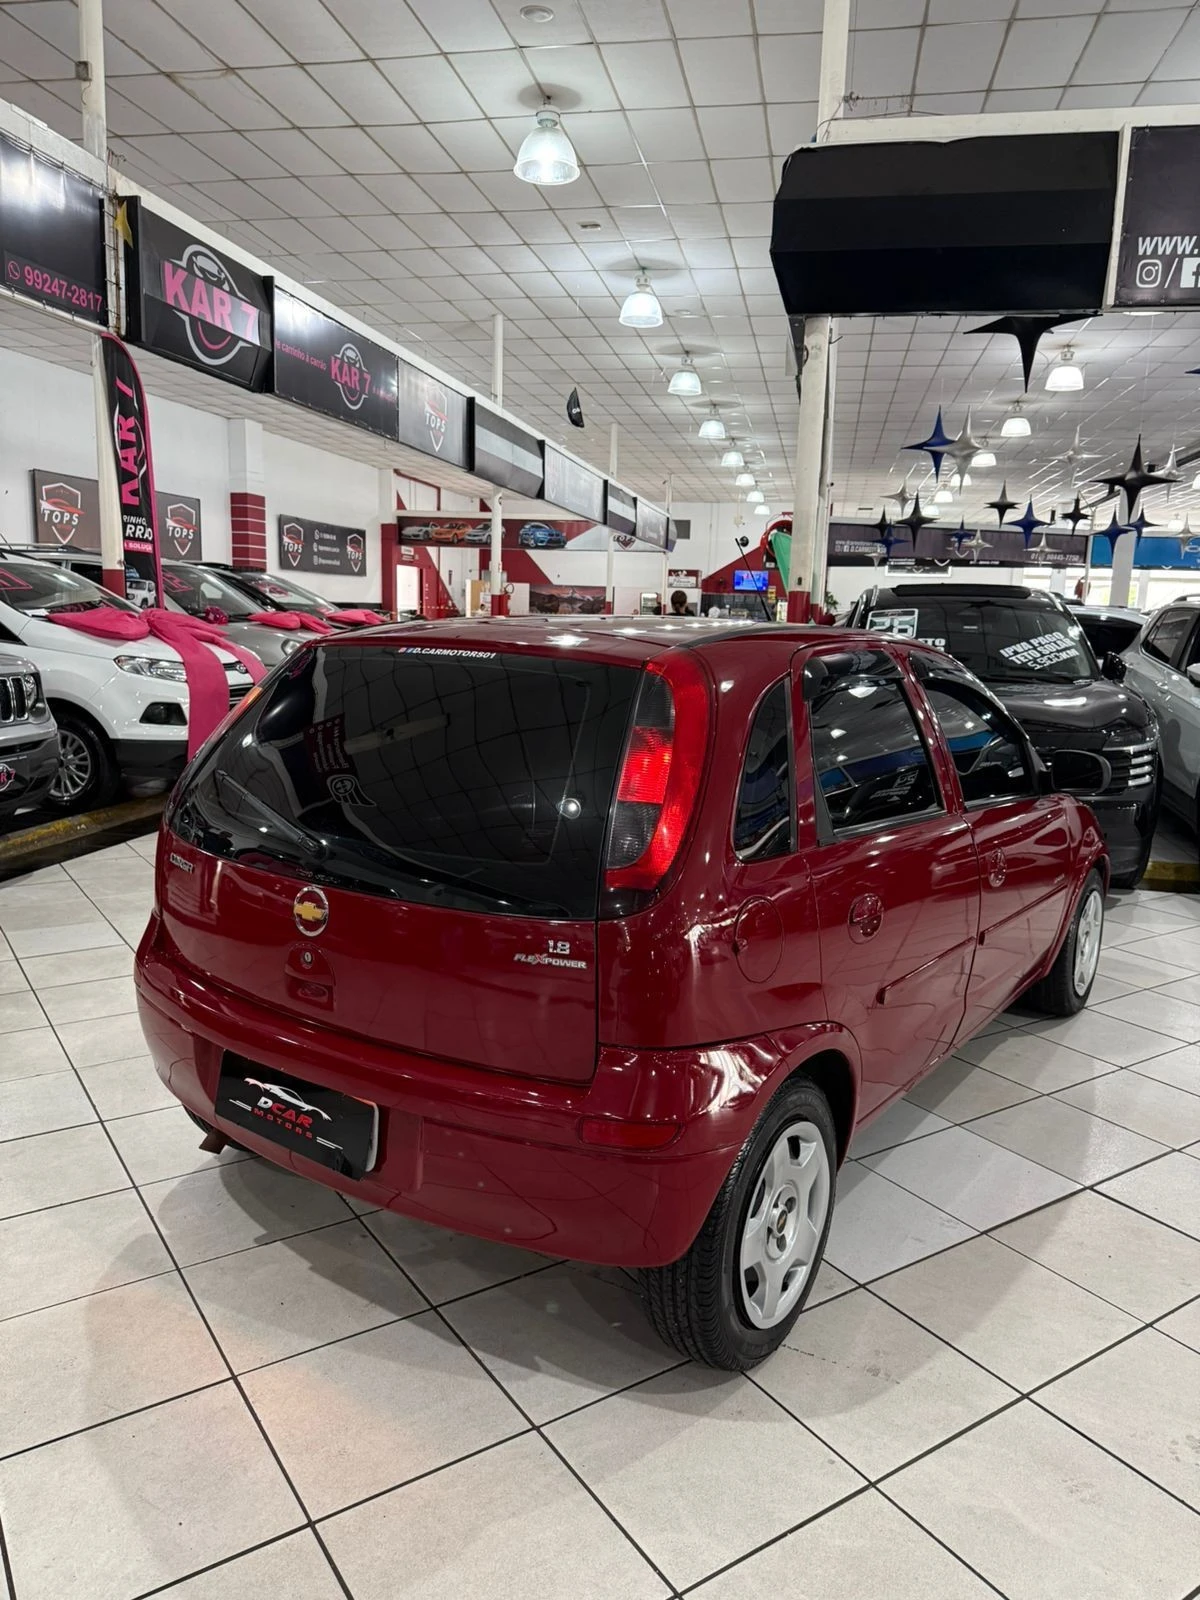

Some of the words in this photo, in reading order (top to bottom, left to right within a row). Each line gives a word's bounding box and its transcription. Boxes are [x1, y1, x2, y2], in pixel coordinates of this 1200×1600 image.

[24, 265, 103, 313] 99247-2817
[164, 260, 235, 335] KAR
[240, 300, 258, 344] 7
[331, 356, 360, 392] KAR
[363, 372, 371, 394] 7
[425, 412, 446, 433] TOPS
[44, 510, 79, 526] TOPS
[168, 526, 194, 540] TOPS
[284, 543, 303, 553] TOPS
[347, 551, 363, 560] TOPS
[412, 647, 497, 660] D.CARMOTORS01
[1000, 641, 1034, 658] IPVA
[1029, 631, 1065, 648] PAGO
[1008, 649, 1042, 665] TETO
[1037, 637, 1076, 655] SOLAR
[548, 940, 571, 954] 1.8
[513, 953, 587, 969] FLEXPOWER
[253, 1107, 313, 1139] MOTORS
[257, 1096, 313, 1129] DCAR
